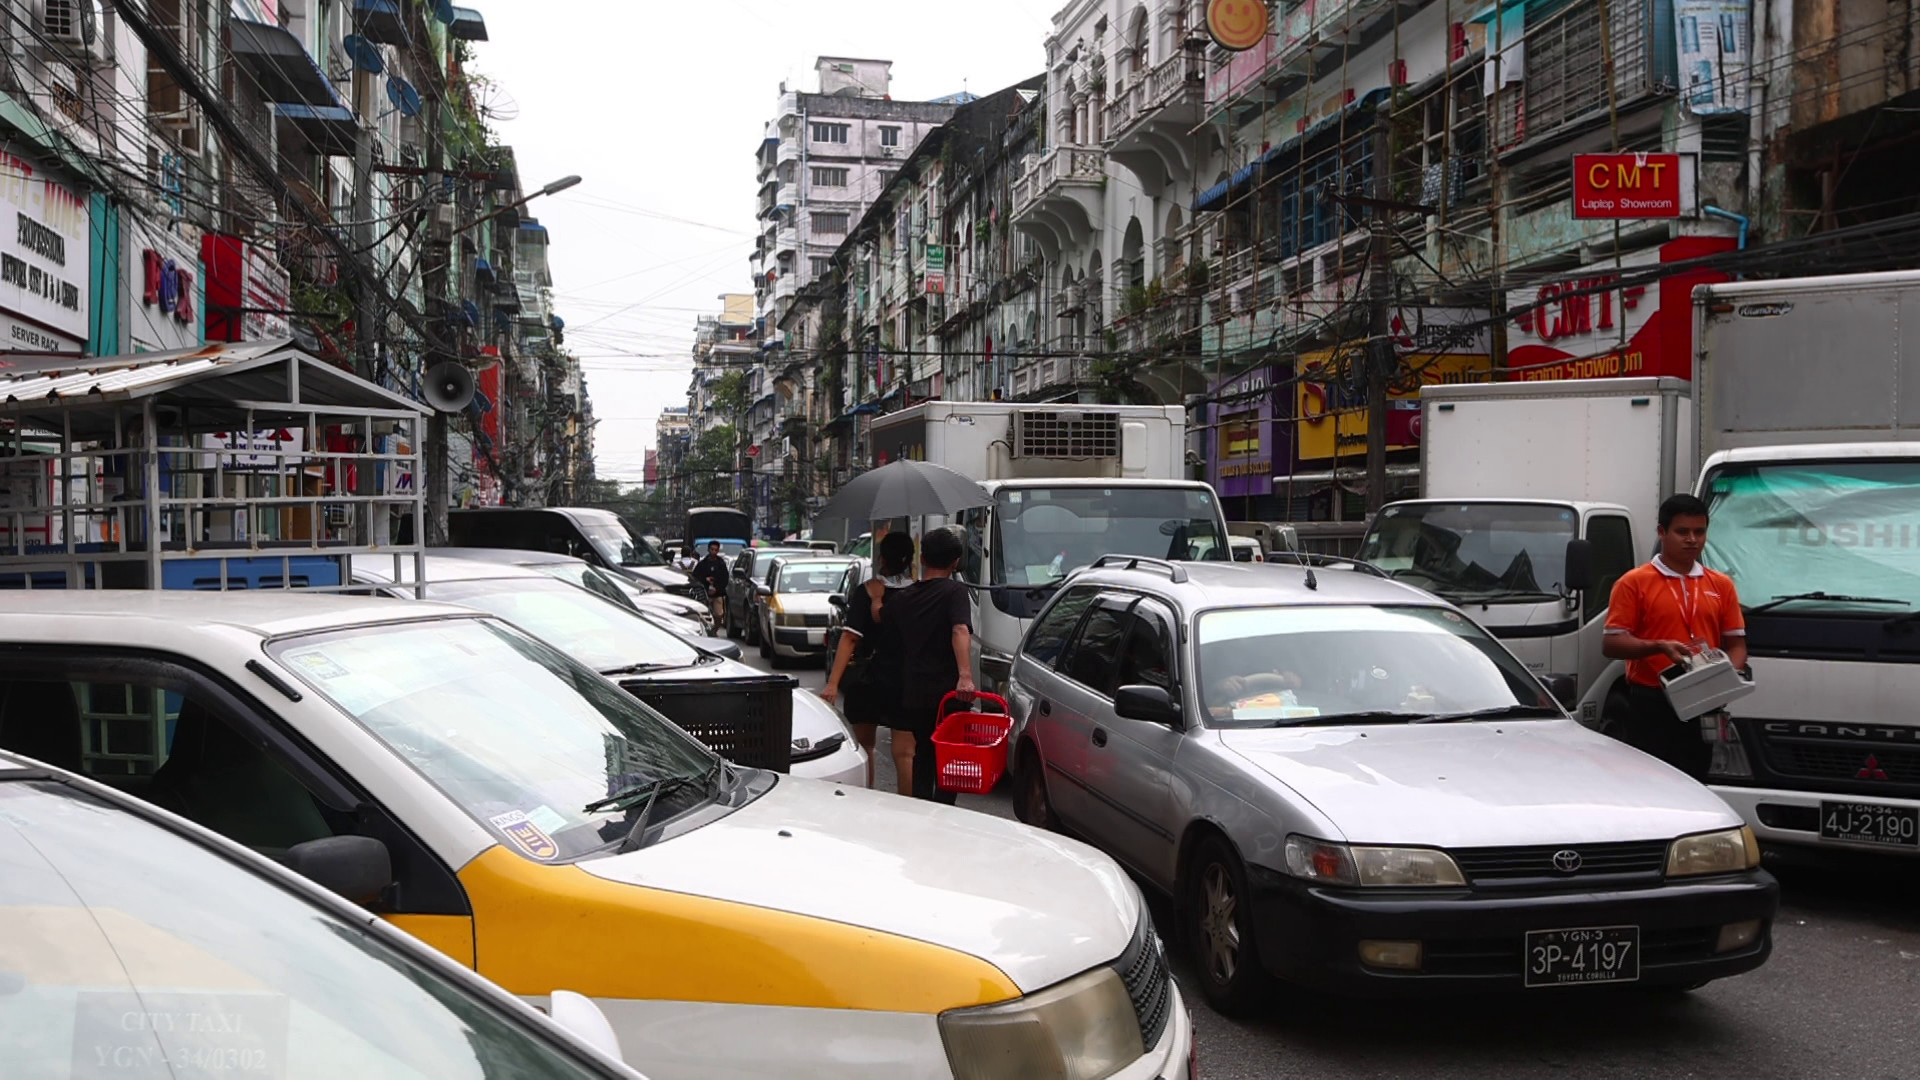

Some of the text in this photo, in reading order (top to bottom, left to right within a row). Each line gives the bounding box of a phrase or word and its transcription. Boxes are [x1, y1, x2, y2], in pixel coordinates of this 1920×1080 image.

[1589, 163, 1666, 189] CMT
[1582, 198, 1672, 211] Laptop Showroom
[1534, 273, 1619, 342] CMT
[11, 325, 60, 352] SERVER RACK
[1773, 521, 1920, 549] TOSHI
[1826, 811, 1914, 838] 4J-2190
[1532, 941, 1632, 974] 3P-4197
[1557, 971, 1616, 981] TOYOTA COROLLA
[121, 1011, 243, 1033] CITY TAXI
[95, 1045, 153, 1067] YGN
[176, 1047, 267, 1070] 34/0302
